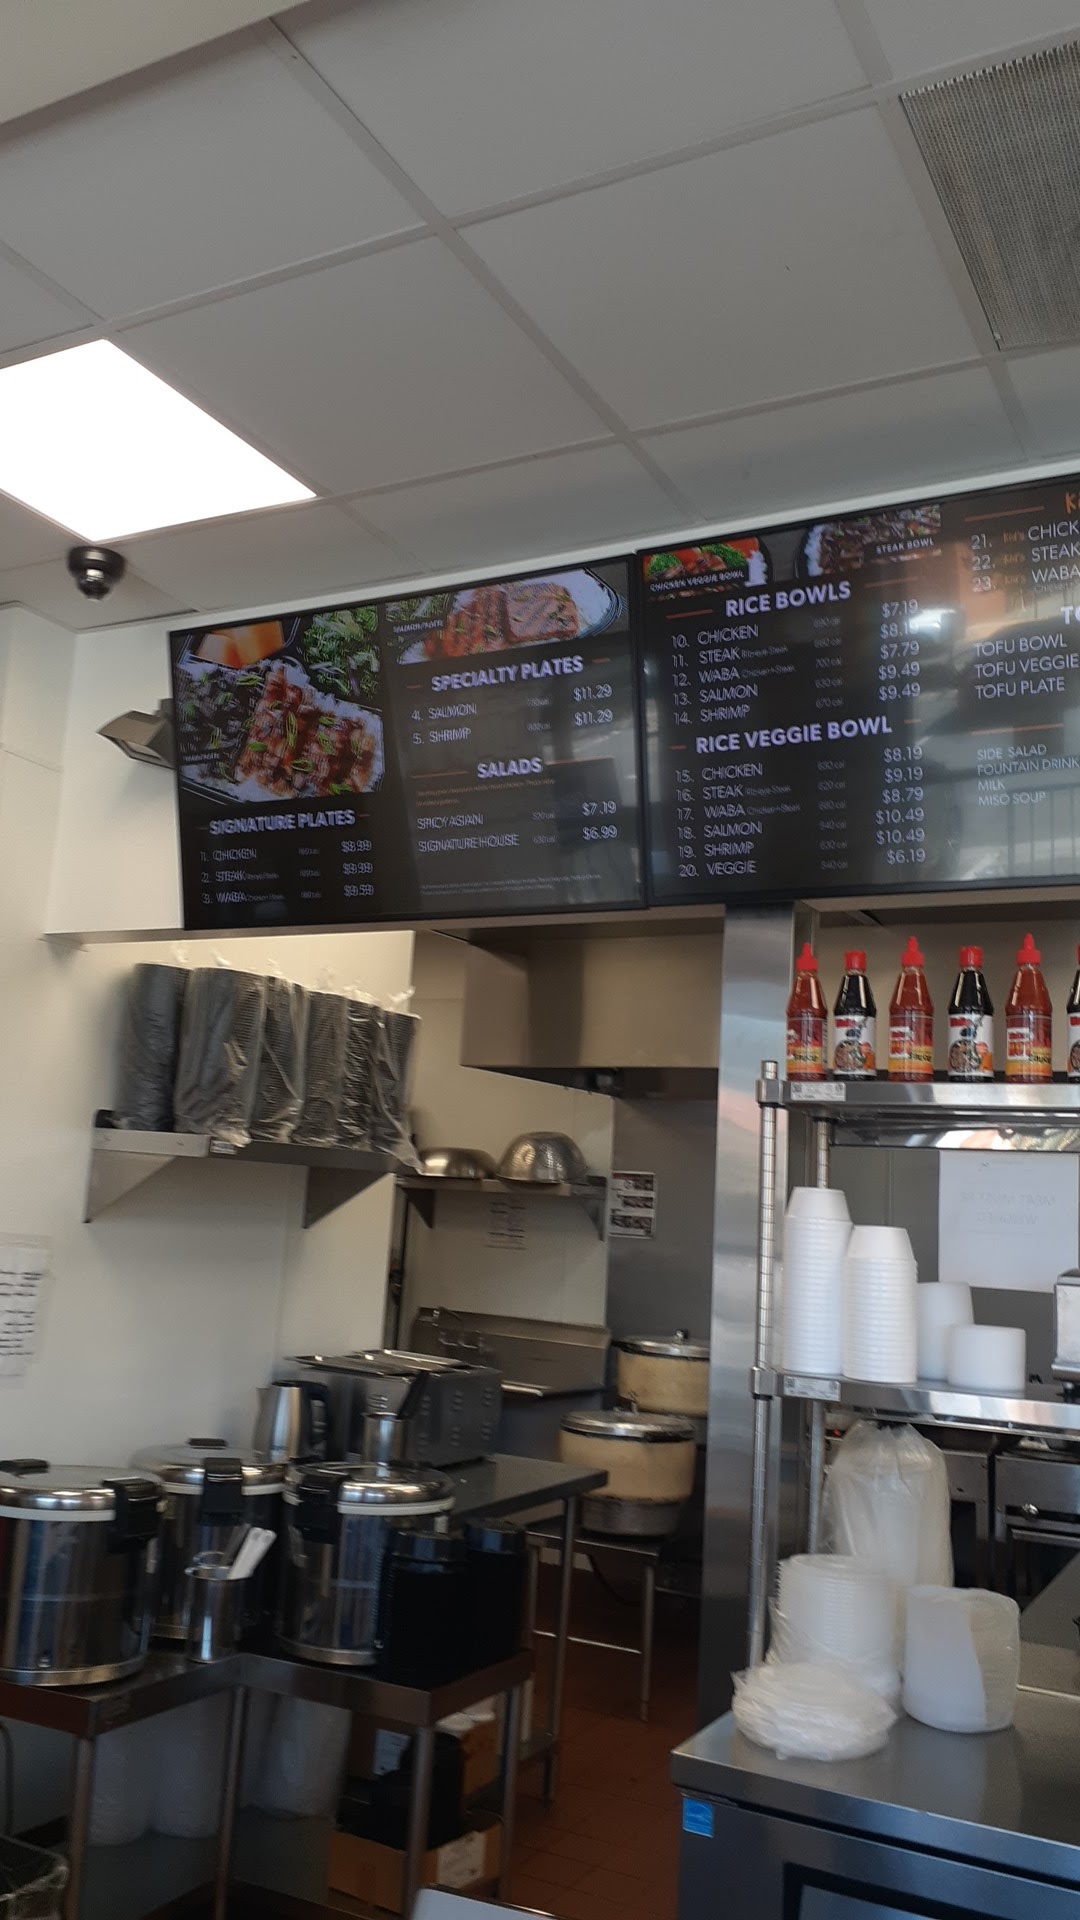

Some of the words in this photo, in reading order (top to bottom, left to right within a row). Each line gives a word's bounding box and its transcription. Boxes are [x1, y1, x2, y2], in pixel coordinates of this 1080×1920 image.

[876, 543, 904, 555] STEAK
[907, 537, 934, 550] BOWL
[971, 533, 993, 550] 21.
[972, 554, 996, 571] 22.
[1031, 541, 1080, 562] STEAK
[650, 579, 686, 592] CHICKEN
[972, 575, 997, 592] 23.
[1031, 563, 1080, 584] WABA
[725, 594, 771, 617] RICE
[775, 580, 851, 609] BOWLS
[671, 634, 690, 648] 10.
[697, 624, 759, 645] CHICKEN
[881, 599, 918, 619] $7.19
[672, 654, 688, 668] 11.
[699, 646, 740, 665] STEAK
[880, 619, 919, 639] $8.19
[974, 639, 1015, 658] TOFU
[1019, 633, 1067, 653] BOWL
[431, 664, 519, 692] SPECIALTY
[521, 655, 584, 680] PLATES
[672, 674, 692, 687] 12.
[698, 667, 740, 684] WABA
[880, 640, 920, 660] $7.79
[974, 661, 1016, 679] TOFU
[1019, 652, 1080, 674] VEGGIE
[672, 692, 692, 706] 13.
[699, 683, 758, 703] SALMON
[878, 661, 920, 681] $9.49
[974, 681, 1017, 700] TOFU
[1020, 677, 1065, 695] PLATE
[428, 703, 477, 719] SALMON
[573, 684, 612, 702] $11.29
[673, 712, 693, 726] 14.
[700, 704, 750, 722] SHRIMP
[878, 682, 921, 701] $9.49
[429, 727, 472, 742] SHRIMP
[574, 709, 614, 726] $11.29
[695, 733, 741, 754] RICE
[744, 723, 822, 749] VEGGIE
[827, 715, 893, 740] BOWL
[675, 769, 695, 783] 15.
[701, 762, 763, 781] CHICKEN
[883, 745, 923, 763] $8.19
[977, 747, 1003, 761] SIDE
[1008, 743, 1047, 758] SALAD
[477, 757, 543, 779] SALADS
[977, 759, 1040, 777] FOUNTAIN
[676, 788, 695, 802] 16.
[702, 783, 744, 800] STEAK
[885, 766, 923, 784] $9.19
[978, 780, 1005, 791] MILK
[677, 807, 695, 821] 17.
[703, 803, 746, 819] WABA
[882, 786, 924, 804] $8.79
[979, 794, 1010, 807] MISO
[1012, 791, 1046, 804] SOUP
[209, 814, 296, 835] SIGNATURE
[298, 809, 356, 828] PLATES
[417, 817, 447, 829] SPICY
[448, 813, 484, 827] ASIAN
[582, 801, 617, 817] $7.19
[677, 826, 696, 839] 18.
[703, 821, 763, 838] SALMON
[875, 807, 925, 825] $10.49
[418, 837, 478, 852] SIGNATURE
[479, 834, 520, 850] HOUSE
[582, 825, 618, 840] $6.99
[678, 845, 697, 859] 19.
[704, 841, 754, 857] SHRIMP
[876, 827, 925, 845] $10.49
[212, 848, 257, 861] CHICKEN
[678, 864, 699, 877] 20.
[706, 860, 757, 876] VEGGIE
[887, 848, 926, 865] $6.19
[215, 870, 246, 882] STEAK
